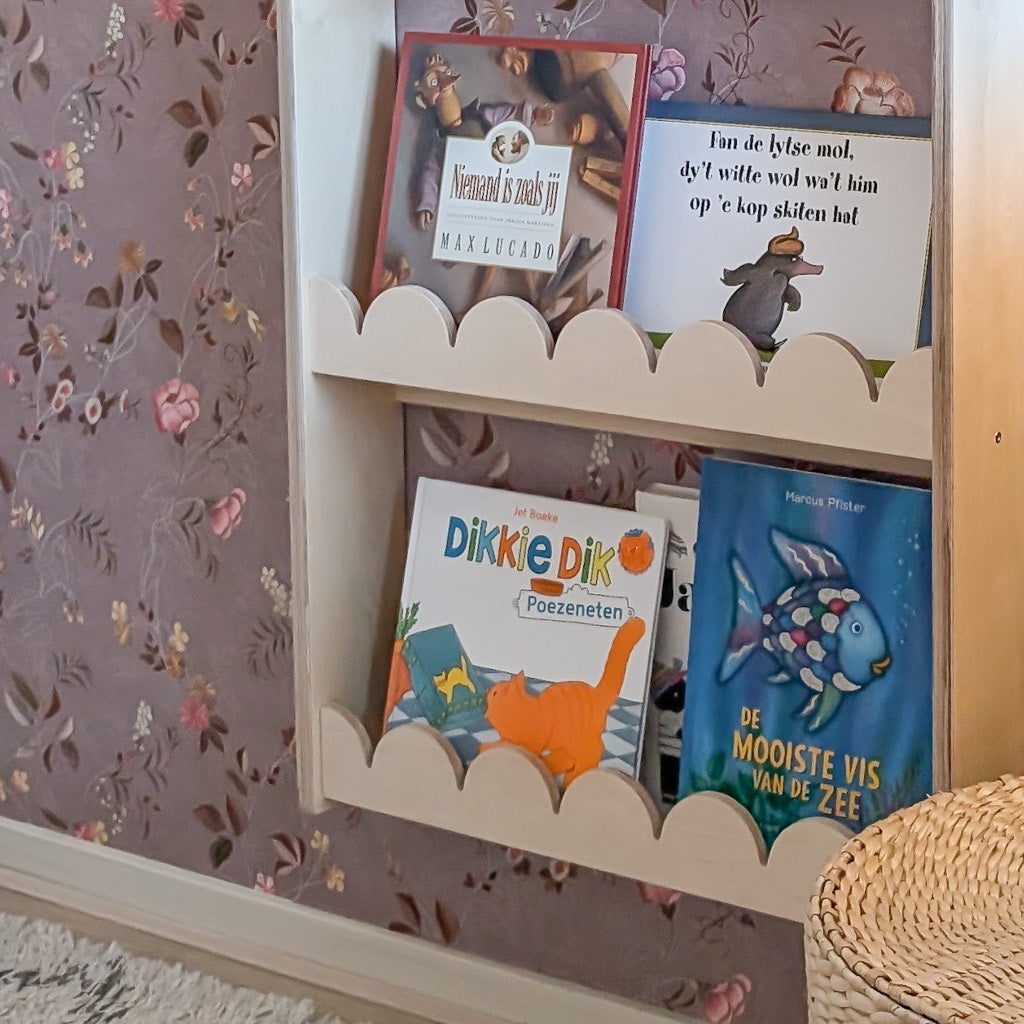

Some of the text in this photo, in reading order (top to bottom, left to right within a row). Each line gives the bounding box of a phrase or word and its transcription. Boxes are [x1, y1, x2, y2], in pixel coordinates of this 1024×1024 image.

[708, 130, 854, 161] Fan de lytse mol,
[450, 163, 560, 216] Niemand is zoals jij
[680, 160, 879, 195] dy't witte wol wa't him
[689, 196, 711, 217] op
[736, 196, 768, 223] kop
[773, 200, 826, 223] skiten
[832, 204, 859, 226] hat
[440, 232, 554, 260] MAX LUCADO
[514, 506, 527, 517] Jet
[785, 490, 866, 513] Marcus Pfister
[444, 515, 616, 587] Dikkie Dik
[527, 595, 624, 621] Poezeneten
[740, 706, 761, 729] DE
[732, 731, 881, 790] MOOISTE VIS
[752, 768, 862, 821] VAN DE ZEE
